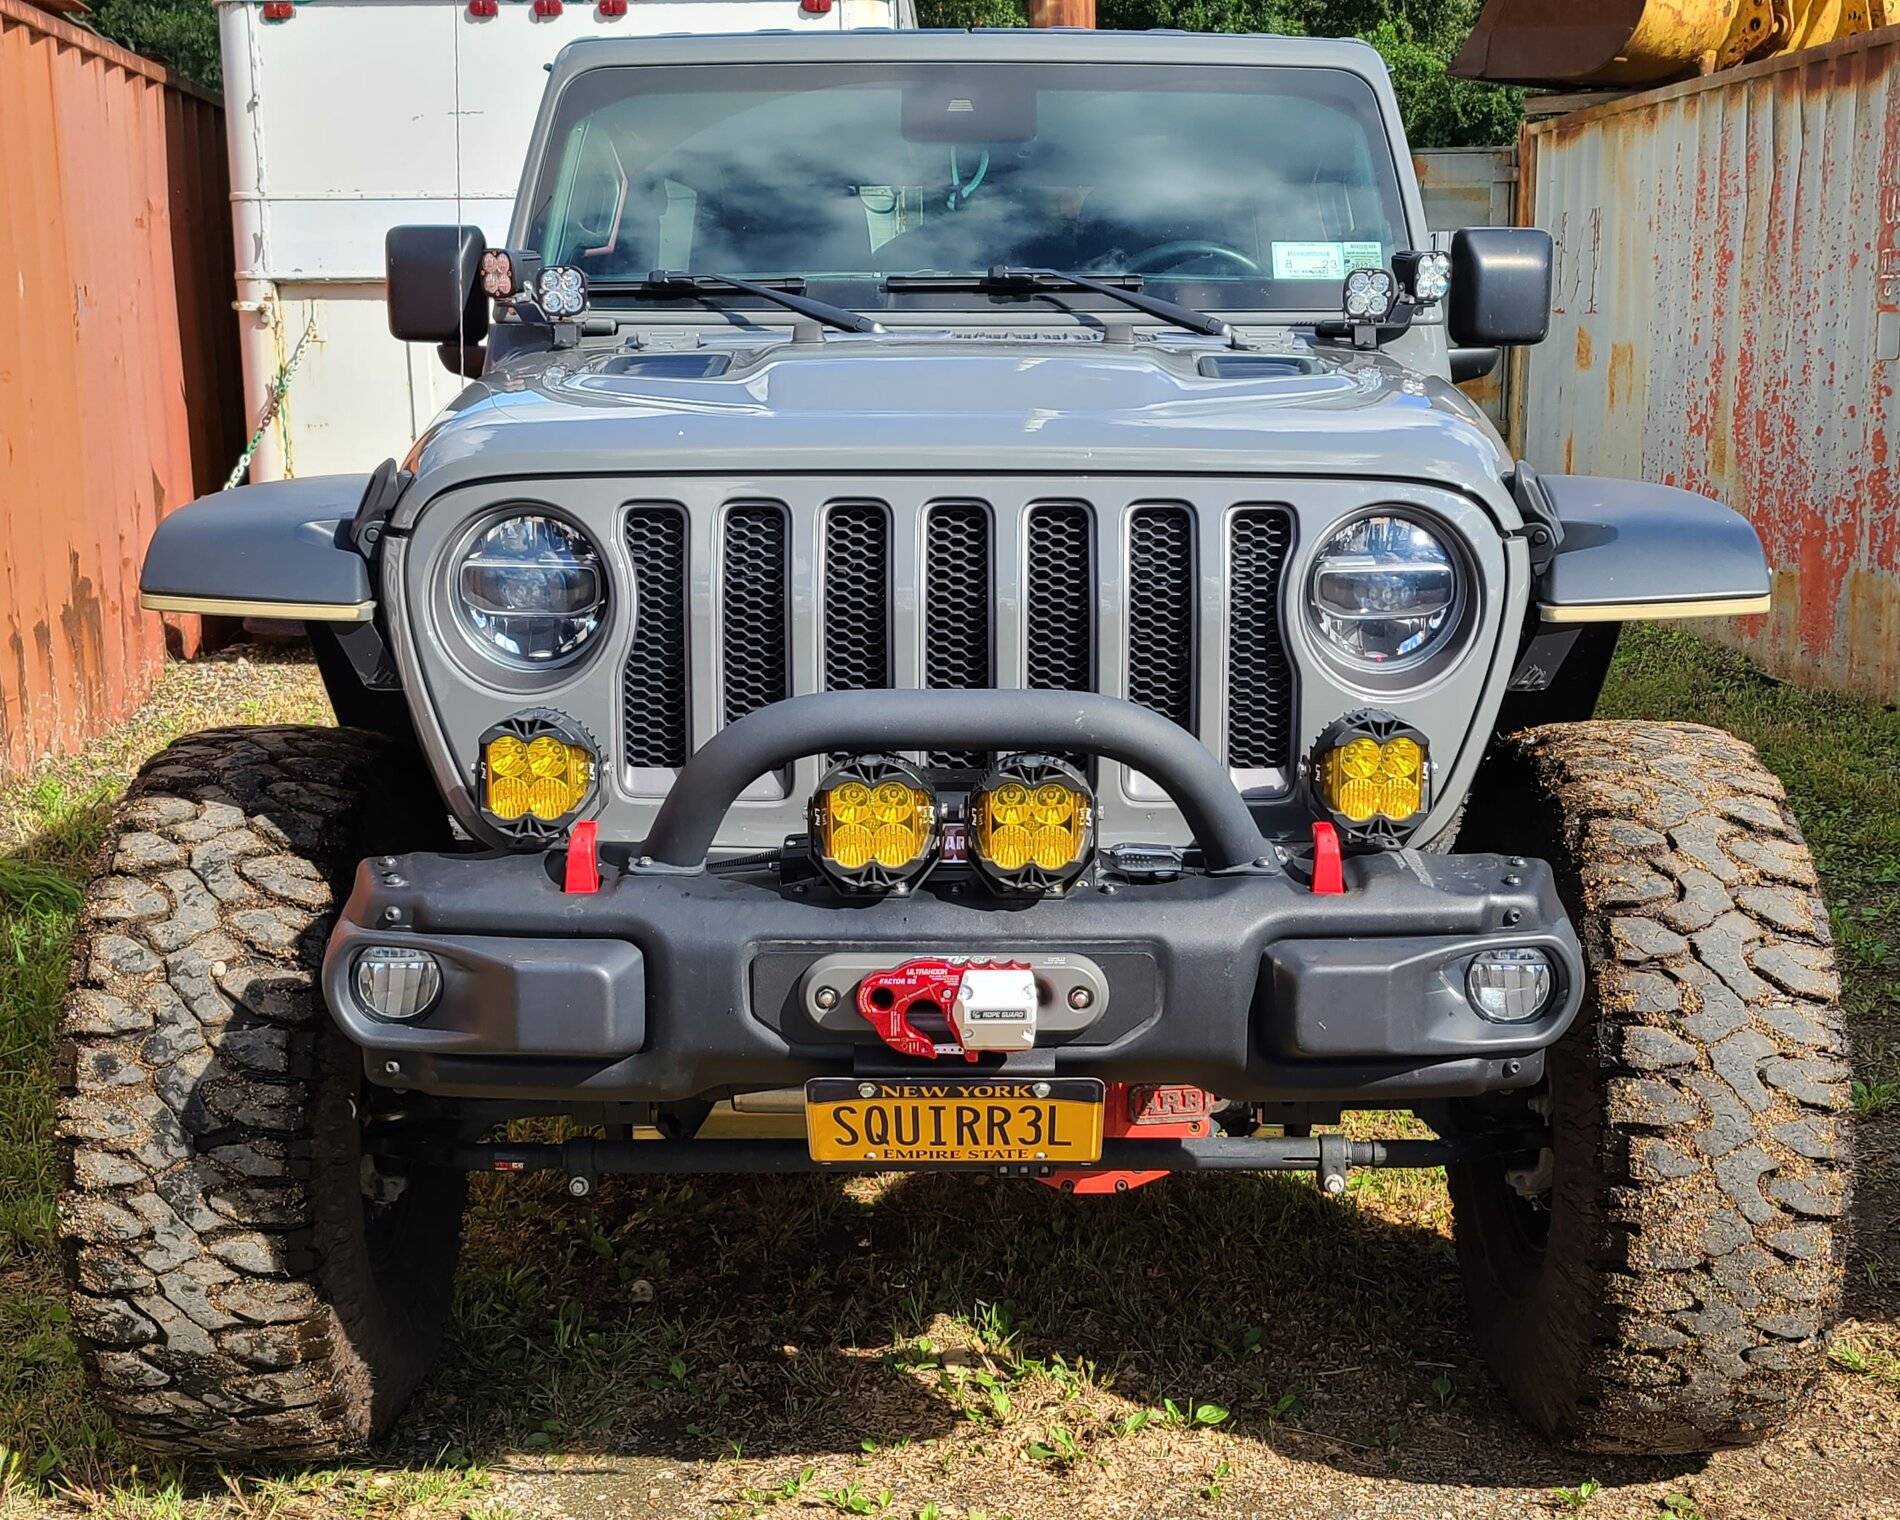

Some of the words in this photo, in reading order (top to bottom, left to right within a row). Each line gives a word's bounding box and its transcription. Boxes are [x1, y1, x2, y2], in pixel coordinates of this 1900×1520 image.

[881, 1085, 956, 1098] NEW
[959, 1085, 1033, 1098] YORK
[832, 1104, 1073, 1147] SQUIRR3L
[882, 1148, 963, 1160] EMPIRE
[967, 1148, 1030, 1160] STATE
